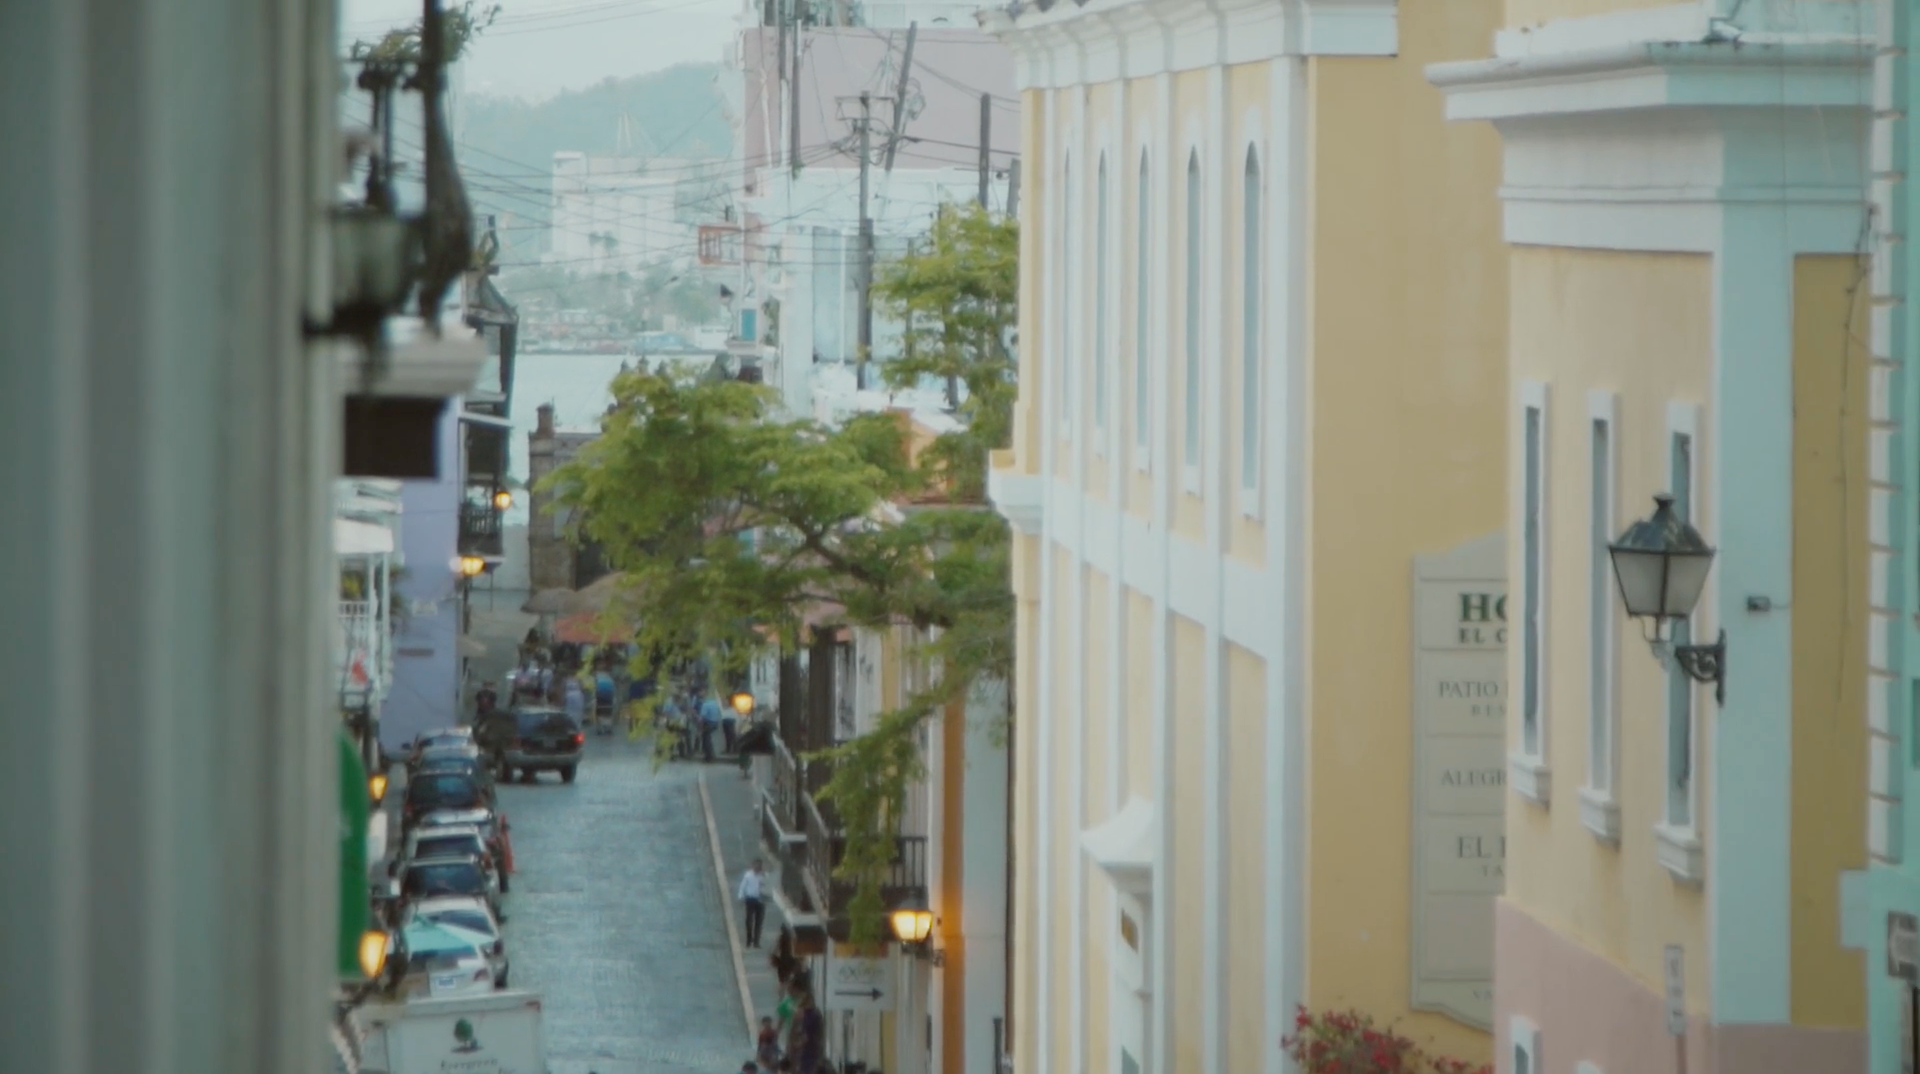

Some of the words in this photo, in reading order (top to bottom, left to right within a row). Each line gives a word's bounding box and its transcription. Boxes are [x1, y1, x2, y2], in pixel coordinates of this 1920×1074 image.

[1459, 628, 1485, 643] EL
[1439, 681, 1499, 698] PATIO
[1458, 836, 1492, 858] EL
